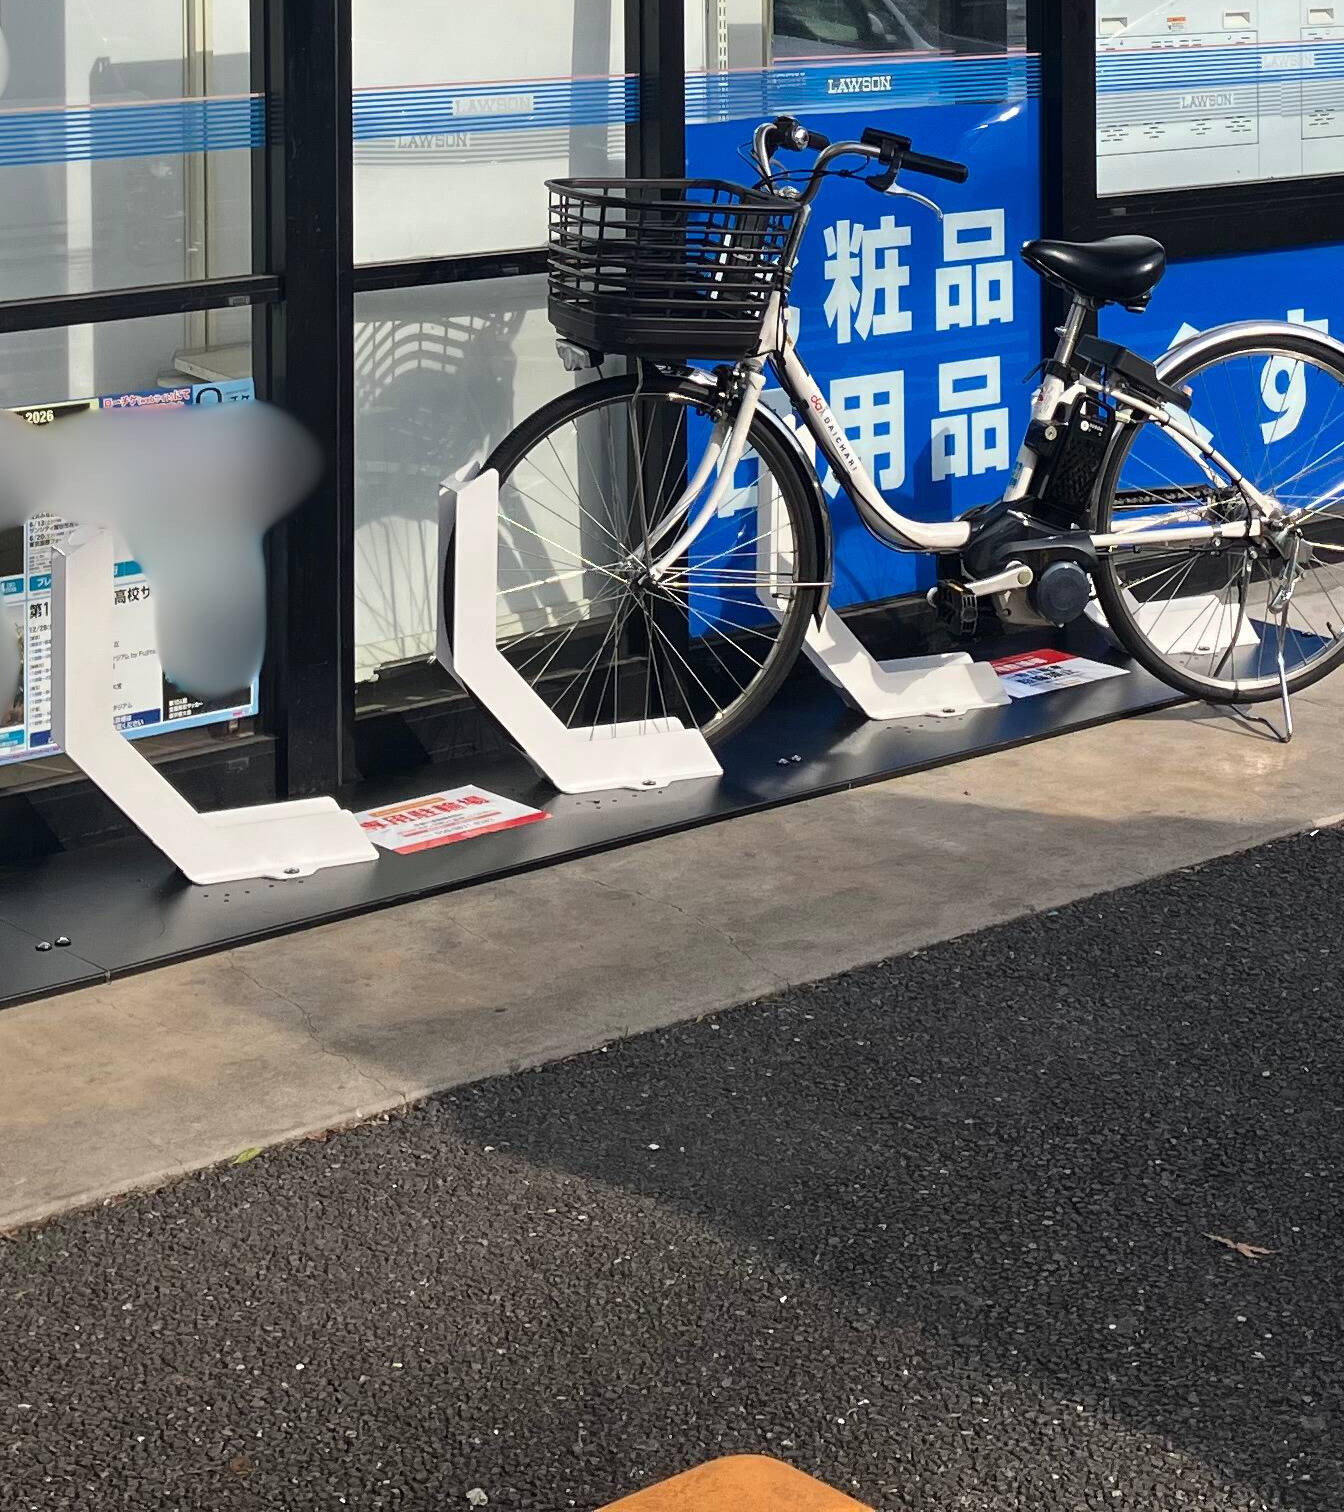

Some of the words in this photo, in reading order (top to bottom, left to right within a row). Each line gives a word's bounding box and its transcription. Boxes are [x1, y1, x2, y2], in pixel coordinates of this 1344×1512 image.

[827, 75, 892, 94] LAWSON
[455, 95, 531, 115] LAWSON
[397, 132, 468, 149] LAWSON
[25, 409, 55, 425] 2026
[824, 416, 858, 472] DAICHARI
